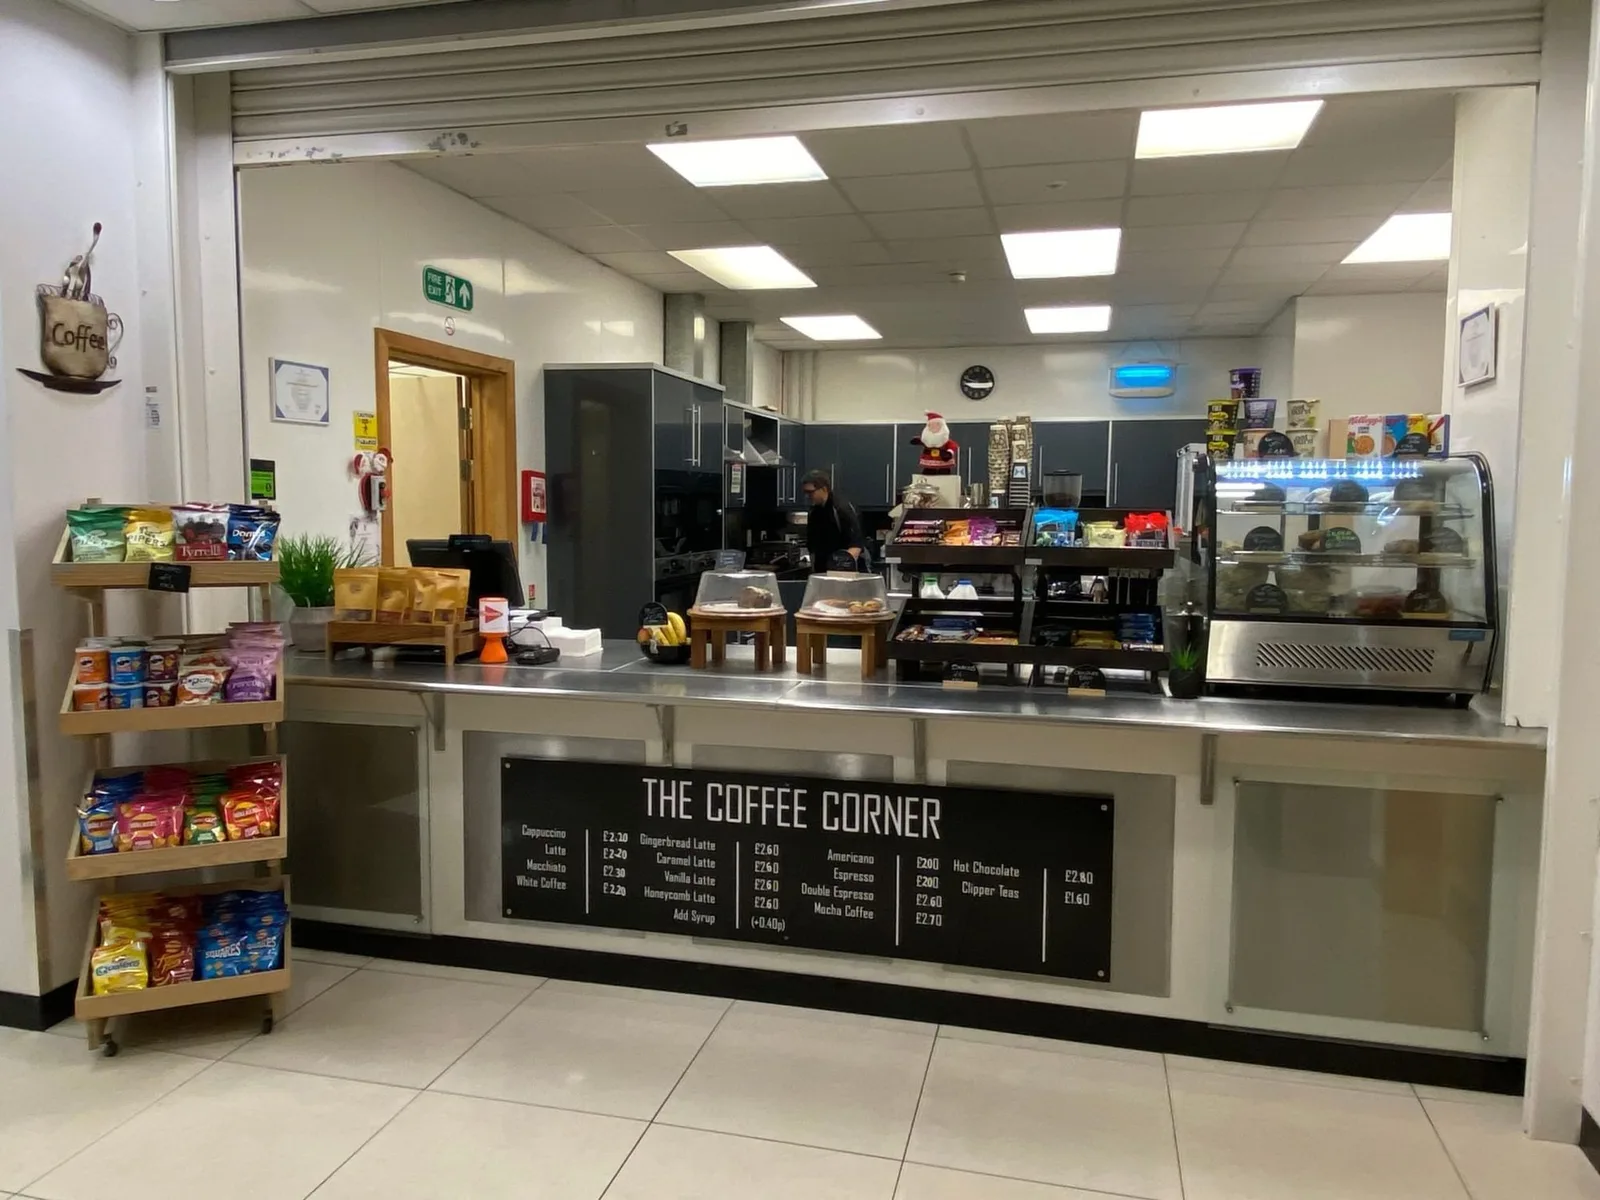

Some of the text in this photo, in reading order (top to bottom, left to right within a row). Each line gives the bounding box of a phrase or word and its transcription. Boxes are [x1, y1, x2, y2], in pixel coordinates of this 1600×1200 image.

[427, 284, 442, 297] EXIT
[52, 322, 105, 353] Coffee
[128, 534, 168, 548] PIPERS
[232, 529, 266, 538] Doris
[642, 777, 941, 840] THE COFFEE CORNER
[521, 823, 567, 839] Cappuccino
[544, 843, 567, 856] Latte
[640, 832, 716, 851] Gingerbread Latte
[656, 851, 716, 869] Caramel Latte
[827, 848, 875, 865] Americano
[526, 858, 567, 874] Macchiato
[953, 858, 1020, 878] Hot Chocolate
[516, 875, 567, 891] White Coffee
[664, 870, 716, 887] Vanilla Latte
[833, 867, 875, 883] Espresso
[1064, 869, 1094, 885] £2.80
[643, 885, 716, 905] Honeycomb Latte
[801, 882, 875, 901] Double Espresso
[961, 880, 1020, 900] Clipper Teas
[1064, 890, 1091, 906] £1.60
[915, 893, 943, 908] £2.60
[673, 908, 716, 926] Add Syrup
[814, 901, 875, 920] Mocha Coffee
